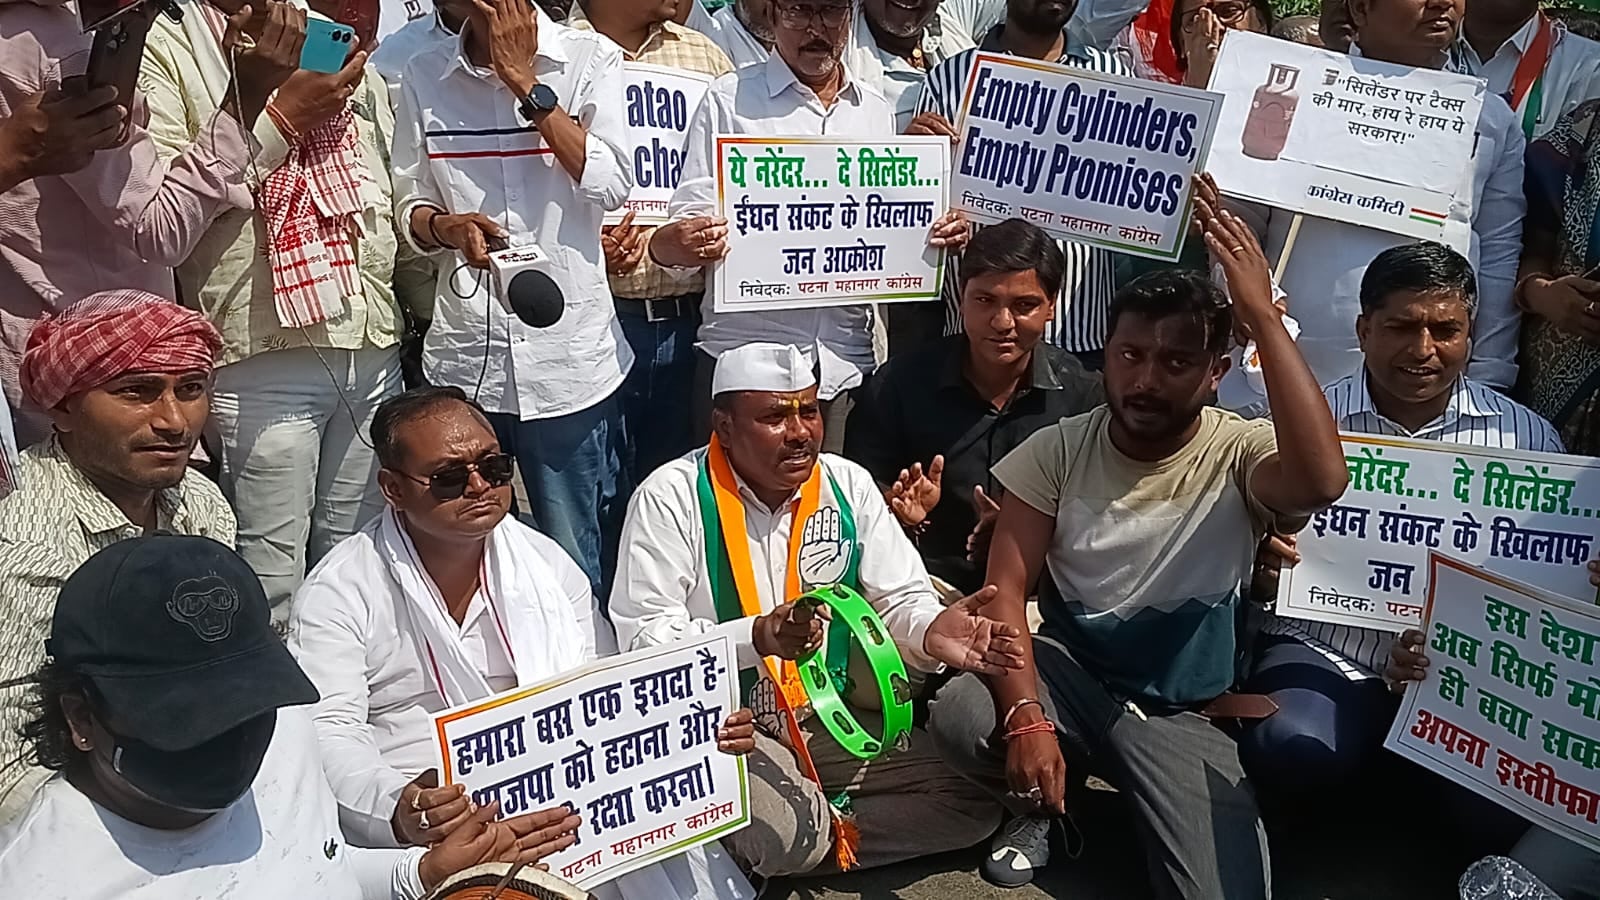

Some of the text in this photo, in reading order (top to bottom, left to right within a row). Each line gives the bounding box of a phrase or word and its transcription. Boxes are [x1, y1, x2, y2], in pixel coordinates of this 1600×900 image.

[626, 80, 687, 132] atao
[969, 68, 1197, 163] Empty Cylinders,
[1312, 91, 1465, 134] की मार, हाय रे हाय ये
[1404, 90, 1426, 105] पर
[1429, 89, 1466, 112] टैक्स
[634, 137, 688, 190] cha
[728, 147, 747, 188] ये
[837, 148, 852, 188] दे
[960, 126, 1183, 216] Empty Promises
[786, 194, 835, 231] संकट
[840, 195, 859, 229] के
[865, 194, 934, 229] खिलाफ
[1308, 184, 1405, 216] कांग्रेस कमिटी
[1020, 206, 1054, 224] पटना
[1060, 214, 1112, 235] महानगर
[1119, 224, 1161, 245] कांग्रेस
[782, 238, 885, 275] जन आक्रोश
[798, 281, 828, 294] पटना
[834, 278, 880, 293] महानगर
[886, 272, 922, 290] कांग्रेस
[1453, 457, 1474, 503] दे
[1379, 503, 1445, 548] संकट
[1452, 512, 1481, 552] के
[1490, 516, 1593, 566] खिलाफ
[1368, 560, 1415, 595] जन
[1385, 601, 1422, 619] पटन
[1484, 594, 1600, 666] इस देश
[1431, 622, 1483, 667] अब
[1490, 640, 1558, 698] सिर्फ
[452, 716, 526, 776] हमारा
[533, 699, 573, 745] बस
[579, 681, 623, 728] एक
[630, 663, 693, 718] इरादा
[1438, 665, 1600, 770] ही बचा सक
[561, 740, 596, 789] को
[601, 721, 670, 775] हटाना
[680, 700, 723, 750] और
[1411, 708, 1600, 824] अपना इस्तीफा
[586, 787, 636, 836] रक्षा
[560, 850, 602, 880] पटना
[610, 823, 677, 858] महानगर
[684, 801, 734, 831] कांग्रेस
